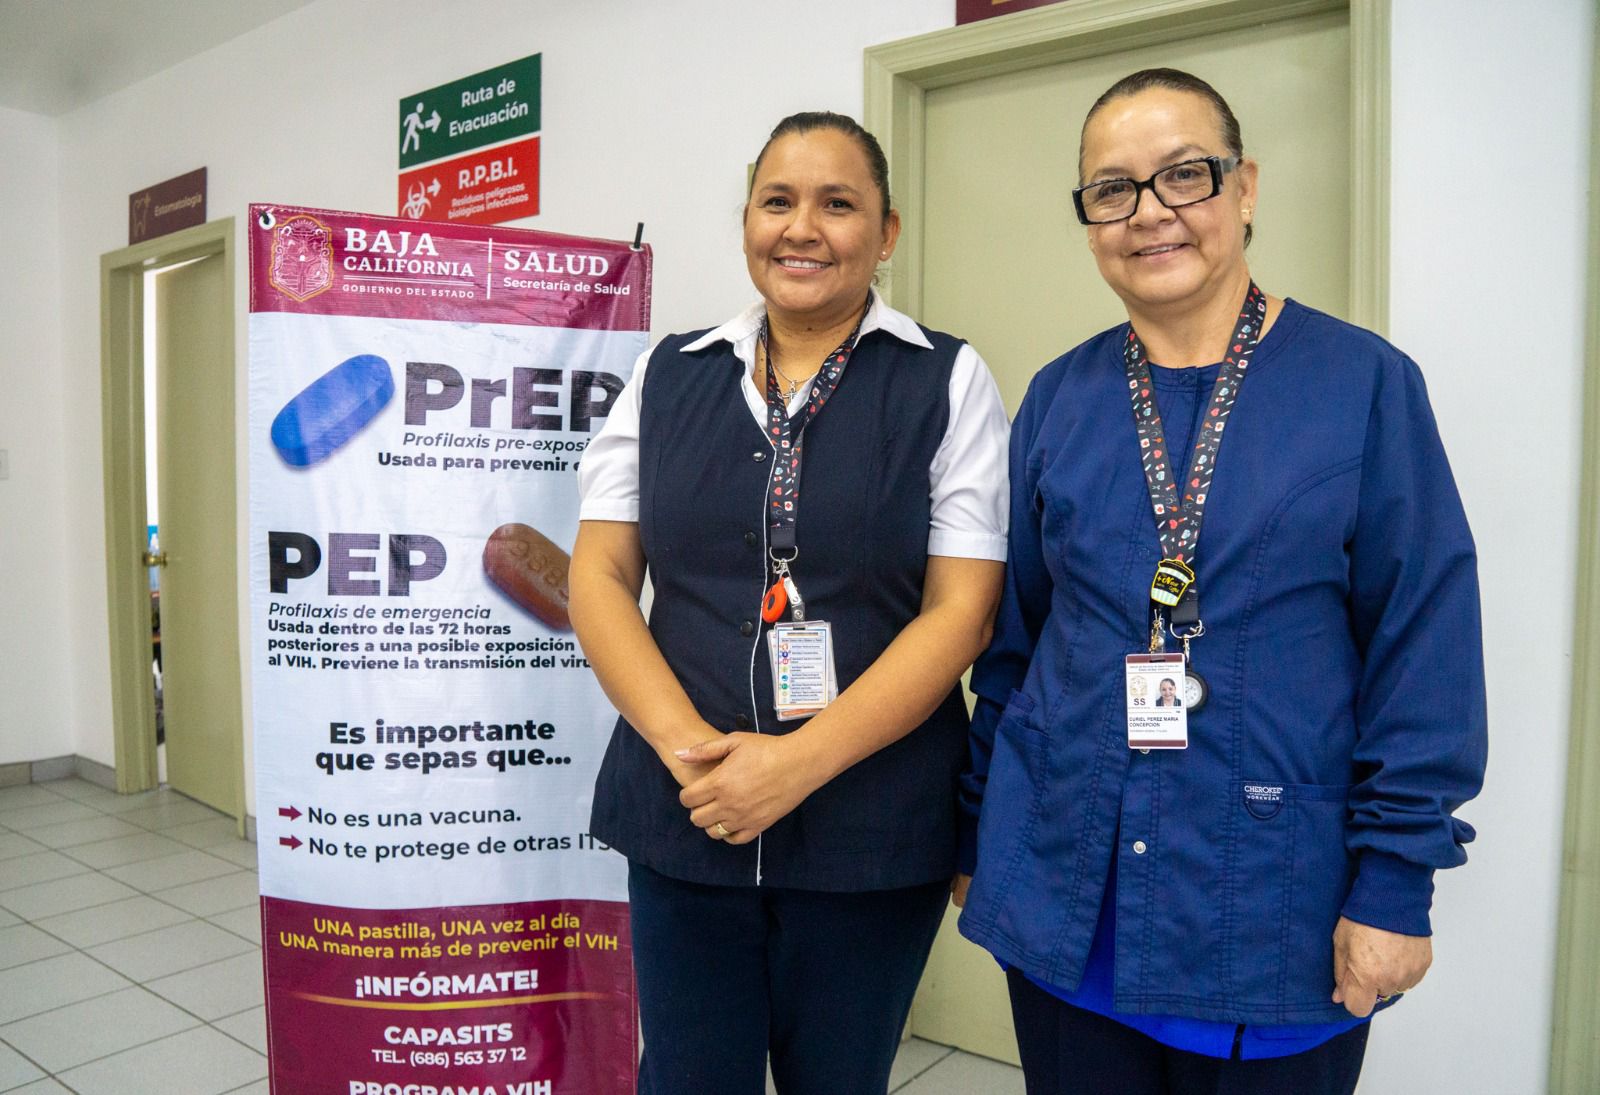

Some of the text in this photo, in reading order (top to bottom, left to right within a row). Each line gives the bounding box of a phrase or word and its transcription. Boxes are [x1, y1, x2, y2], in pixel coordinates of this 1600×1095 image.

[461, 78, 516, 108] Ruta de
[449, 101, 529, 137] Evacuación
[458, 157, 518, 190] R.P.B.I.
[448, 193, 529, 219] biológicos infecciosos
[451, 183, 526, 208] Residuos peligrosos
[344, 227, 439, 257] BAJA
[343, 256, 475, 277] CALIFORNIA
[504, 250, 609, 277] SALUD
[342, 284, 475, 299] GOBIERNO DEL ESTADO
[503, 277, 631, 296] Secretaría de Salud
[404, 361, 626, 433] PrEP
[403, 432, 490, 449] Profilaxis
[378, 451, 437, 468] Usada
[443, 455, 485, 471] para
[490, 456, 567, 472] prevenir
[268, 531, 447, 597] PEP
[269, 602, 491, 622] Profilaxis de emergencia
[268, 619, 511, 635] Usada dentro de las 72 horas
[268, 638, 575, 655] posteriores a una posible exposición
[268, 654, 281, 666] al
[285, 655, 316, 669] VIH.
[321, 656, 399, 669] Previene
[404, 656, 419, 669] la
[425, 655, 525, 669] transmisión
[530, 655, 555, 668] del
[330, 718, 555, 748] Es importante
[316, 748, 572, 775] que sepas que...
[1244, 785, 1283, 793] CHEROKEE
[308, 806, 521, 827] No es una vacuna.
[309, 837, 338, 857] No
[344, 841, 367, 859] te
[375, 841, 470, 863] protege
[477, 836, 507, 855] de
[513, 835, 571, 853] otras
[313, 912, 580, 941] UNA pastilla, UNA vez al día
[279, 931, 618, 959] UNA manera más de prevenir el VIH
[355, 969, 539, 998] ¡INFÓRMATE!
[384, 1022, 513, 1046] CAPASITS
[371, 1046, 527, 1068] TEL. (686) 563 37 12
